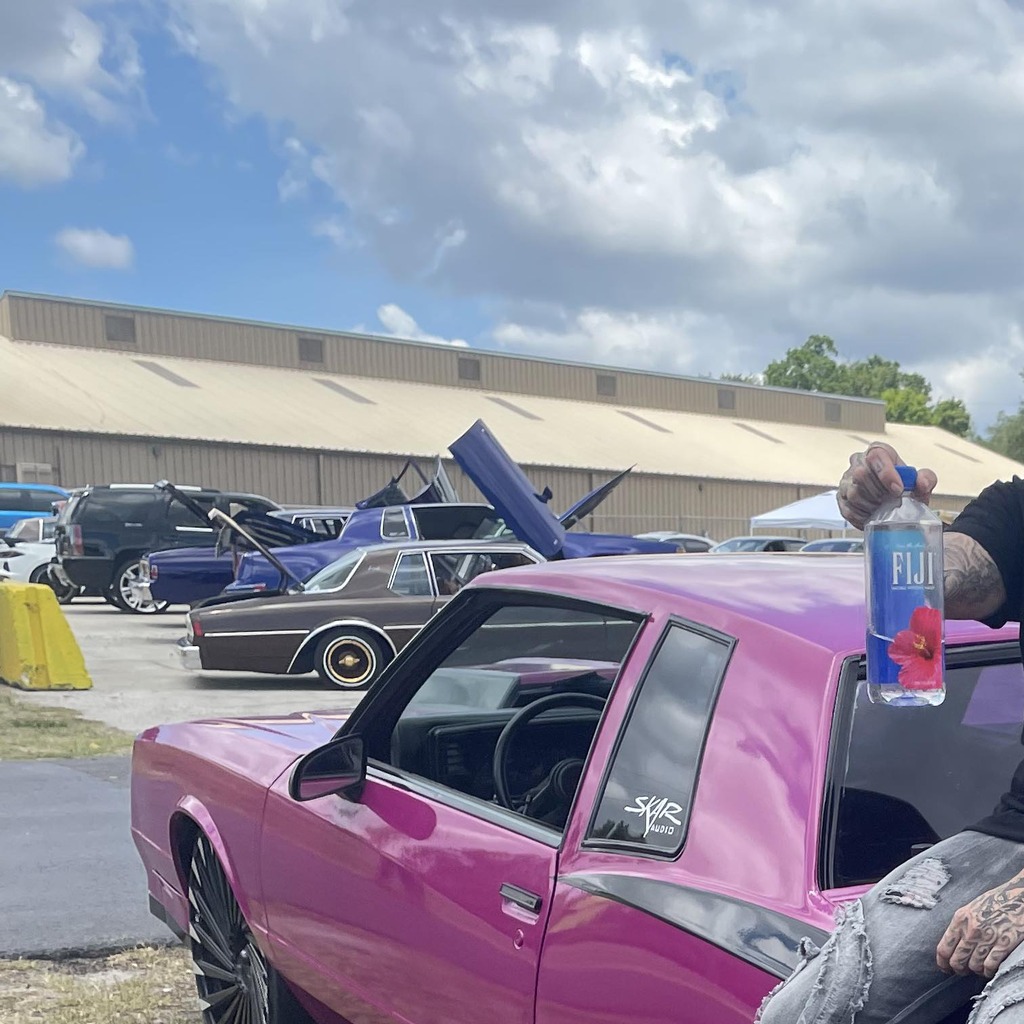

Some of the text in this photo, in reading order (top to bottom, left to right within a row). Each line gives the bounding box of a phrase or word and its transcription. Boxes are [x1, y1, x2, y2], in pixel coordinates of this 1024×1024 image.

[892, 551, 934, 585] FIJI
[623, 795, 683, 838] SKAR
[650, 823, 675, 835] AUDIO
